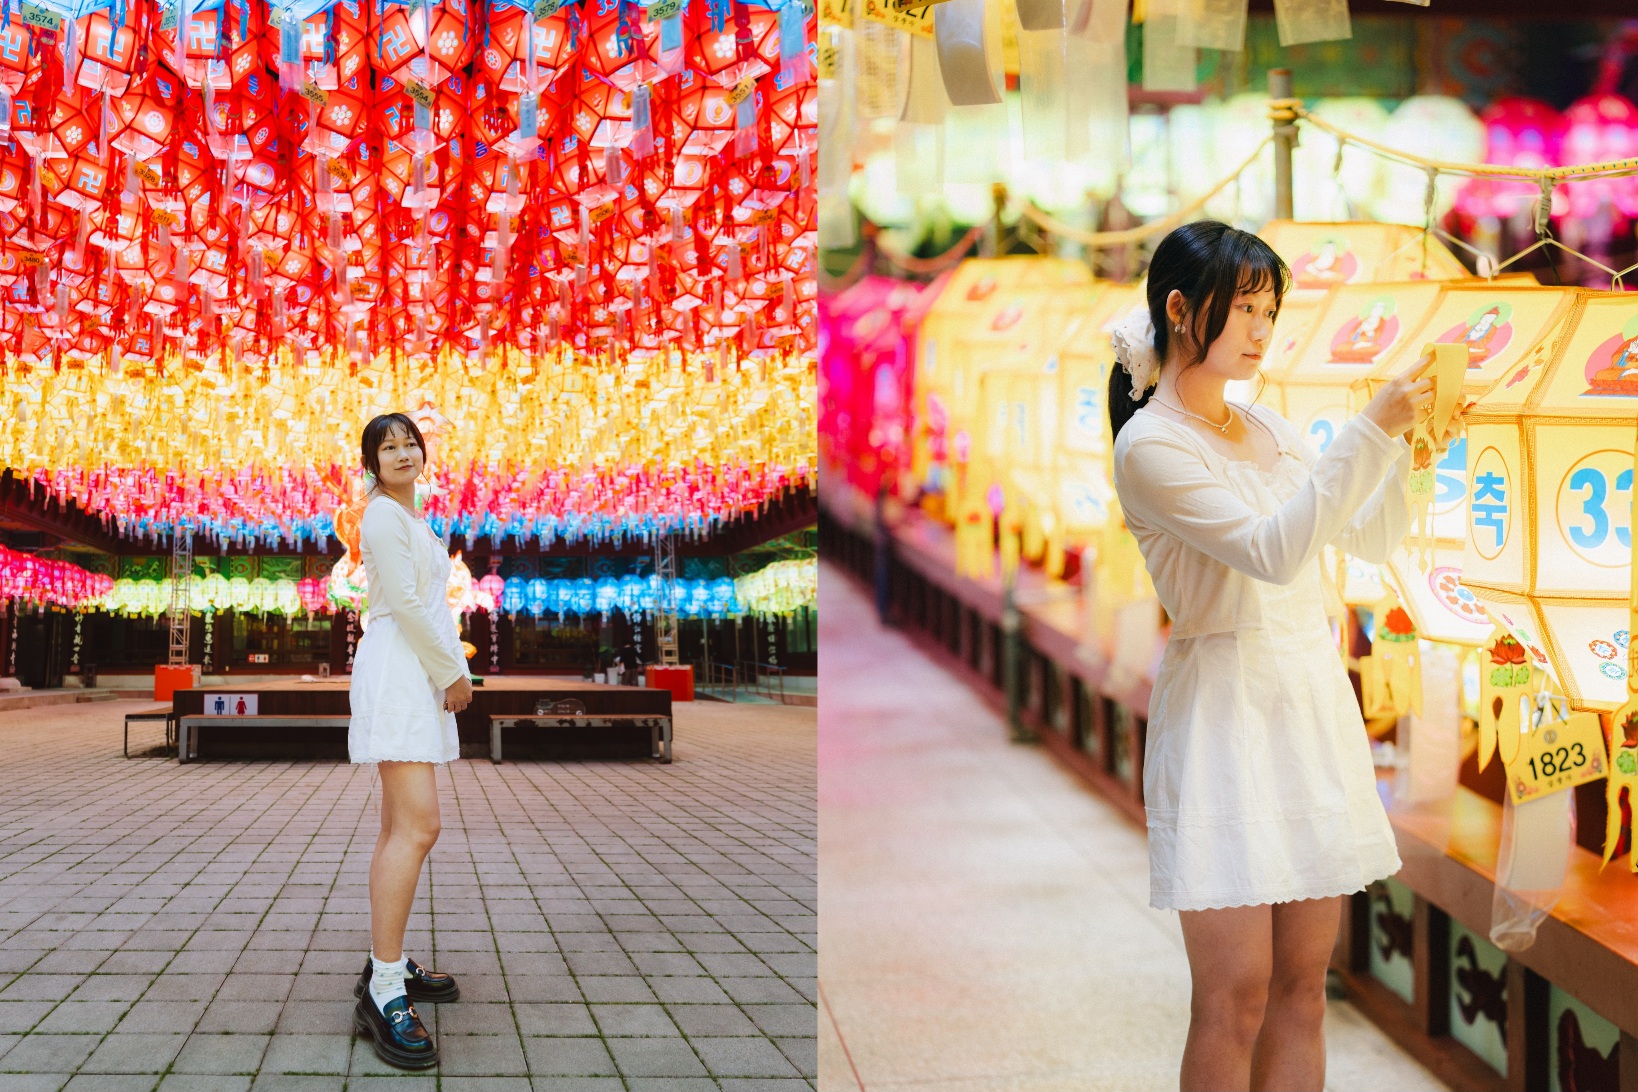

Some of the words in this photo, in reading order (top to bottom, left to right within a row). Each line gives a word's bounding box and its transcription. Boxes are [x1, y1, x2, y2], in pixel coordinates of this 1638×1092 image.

[537, 2, 556, 17] 3578
[653, 2, 676, 17] 3579
[28, 12, 54, 25] 3574
[304, 88, 324, 102] 3555
[409, 87, 429, 102] 3554
[156, 212, 170, 223] 3511
[24, 256, 40, 264] 3480
[1472, 472, 1508, 547] 축
[1529, 743, 1586, 780] 1823
